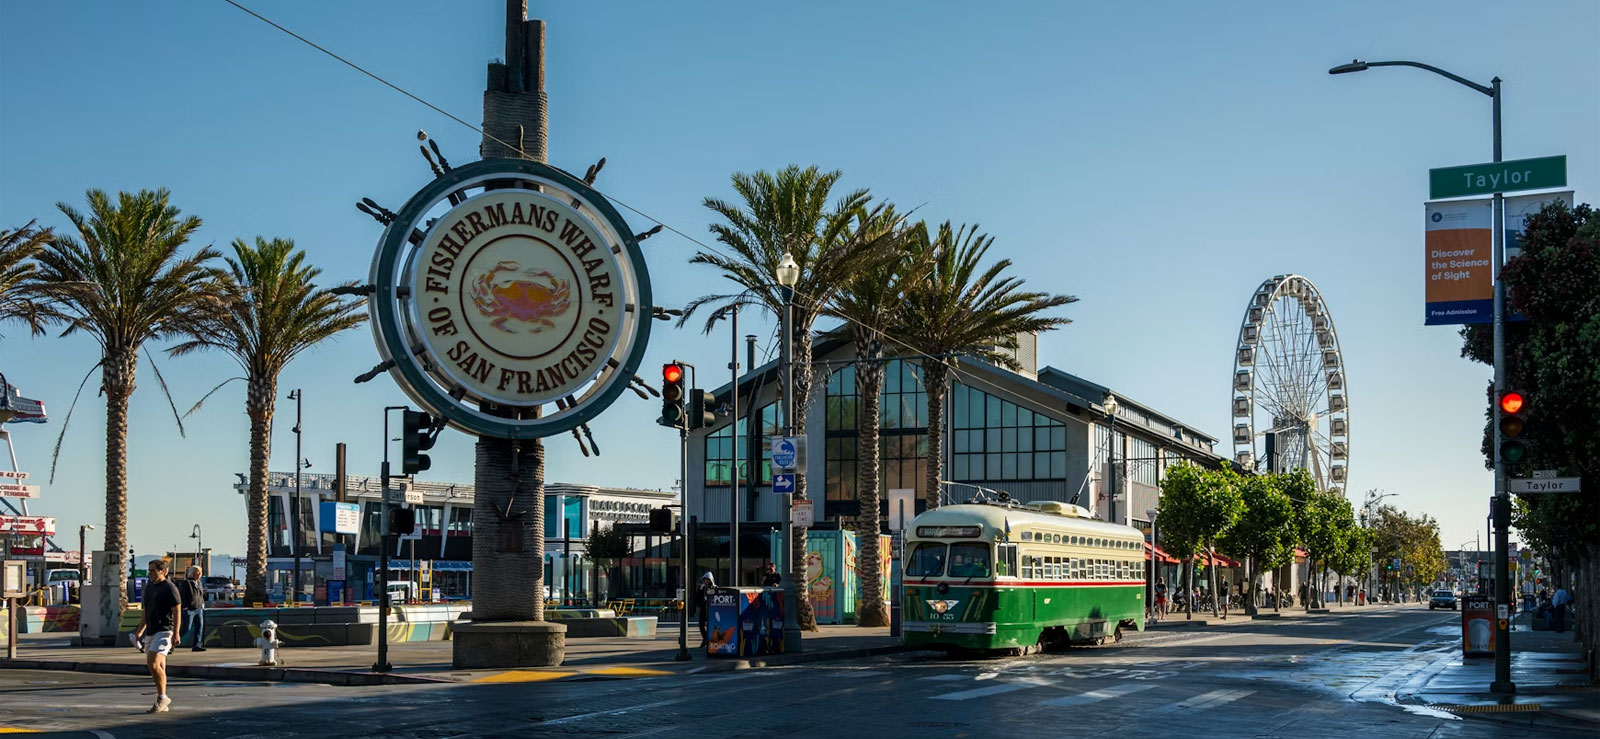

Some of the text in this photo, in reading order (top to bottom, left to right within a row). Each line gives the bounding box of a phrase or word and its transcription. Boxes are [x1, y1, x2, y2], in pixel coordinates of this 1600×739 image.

[1463, 169, 1532, 189] Taylor
[425, 202, 614, 308] FISHERMANS WHARF
[1431, 248, 1475, 259] Discover
[1431, 259, 1489, 270] the Science
[1431, 270, 1470, 282] of Sight
[1446, 308, 1477, 316] Admission
[428, 305, 610, 394] OF SAN FRANCISCO
[1526, 481, 1564, 491] Taylor
[392, 491, 420, 501] Jefrson
[713, 595, 733, 604] PORT
[1469, 601, 1490, 609] PORT
[709, 643, 736, 651] BOATING
